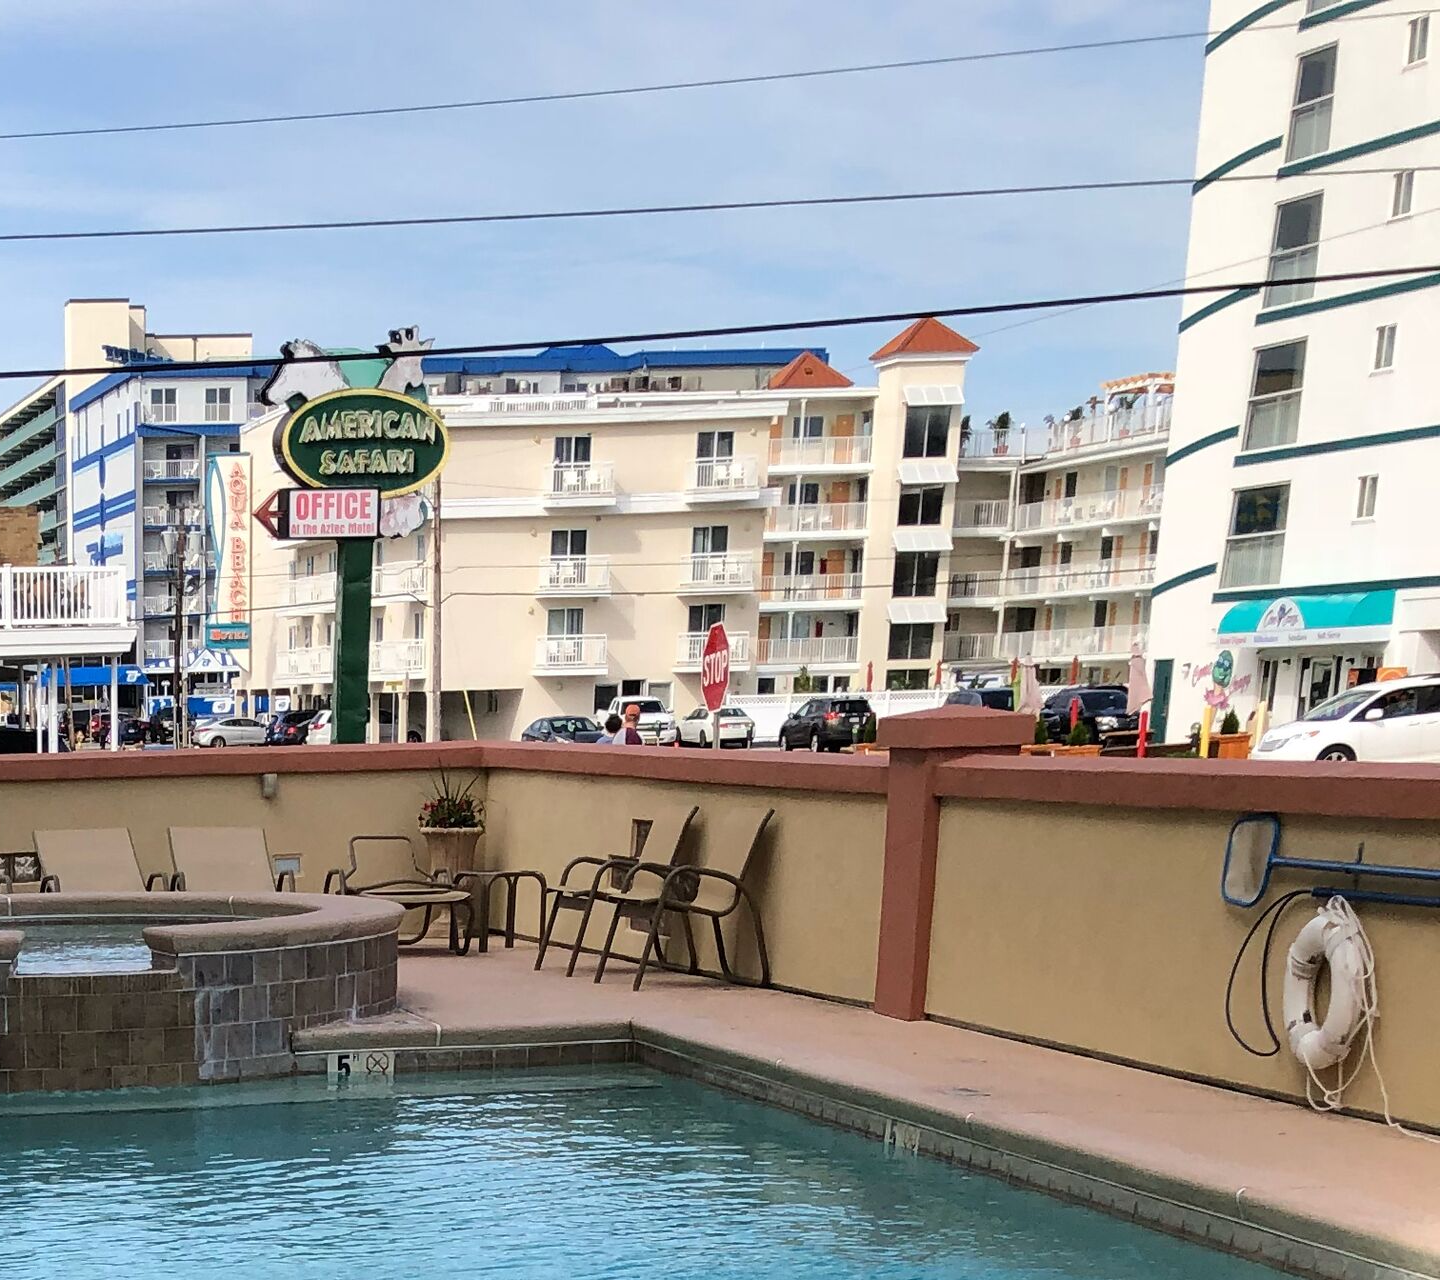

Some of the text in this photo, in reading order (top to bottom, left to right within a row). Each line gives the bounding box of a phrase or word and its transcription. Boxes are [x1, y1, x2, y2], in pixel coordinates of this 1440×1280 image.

[298, 409, 436, 445] AMERICAN
[318, 449, 415, 475] SAFARI
[295, 491, 372, 521] OFFICE
[228, 462, 247, 624] AQUA BEACH
[303, 524, 318, 535] the
[320, 523, 345, 534] Aztec
[348, 522, 375, 534] Motel
[704, 649, 728, 687] STOP
[338, 1054, 351, 1077] 5
